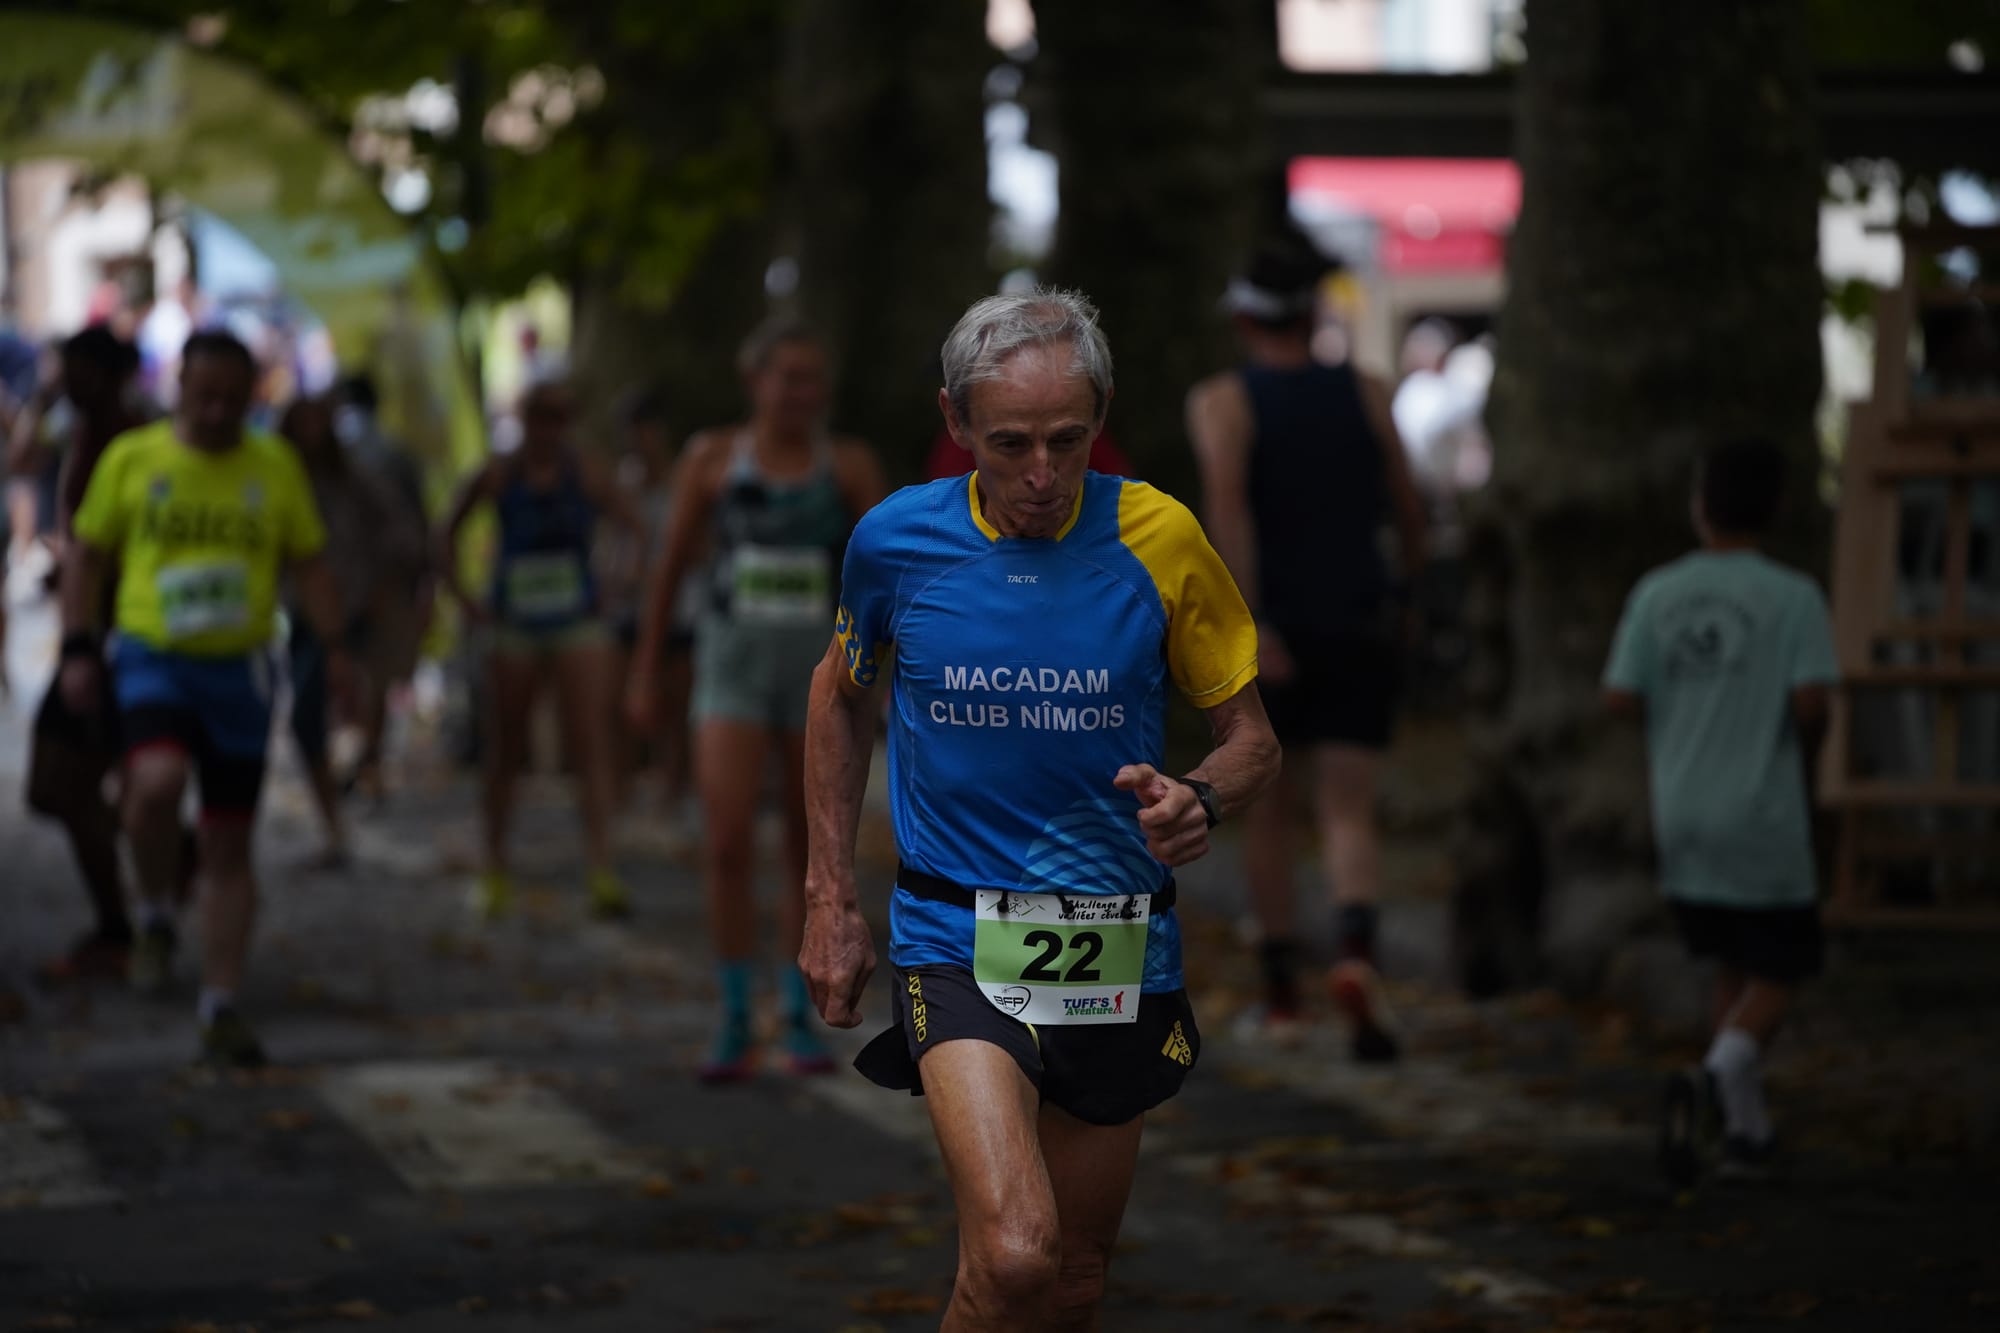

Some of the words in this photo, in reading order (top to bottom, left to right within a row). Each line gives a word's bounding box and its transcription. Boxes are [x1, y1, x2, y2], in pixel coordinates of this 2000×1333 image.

[1007, 575, 1038, 584] TACTIC
[944, 665, 1109, 693] MACADAM
[930, 700, 1009, 727] CLUB
[1020, 700, 1125, 732] NÎMOIS
[1020, 930, 1103, 982] 22
[1062, 997, 1110, 1009] TUFF'S
[1065, 1006, 1114, 1016] Aventure
[1173, 1019, 1192, 1067] adidas
